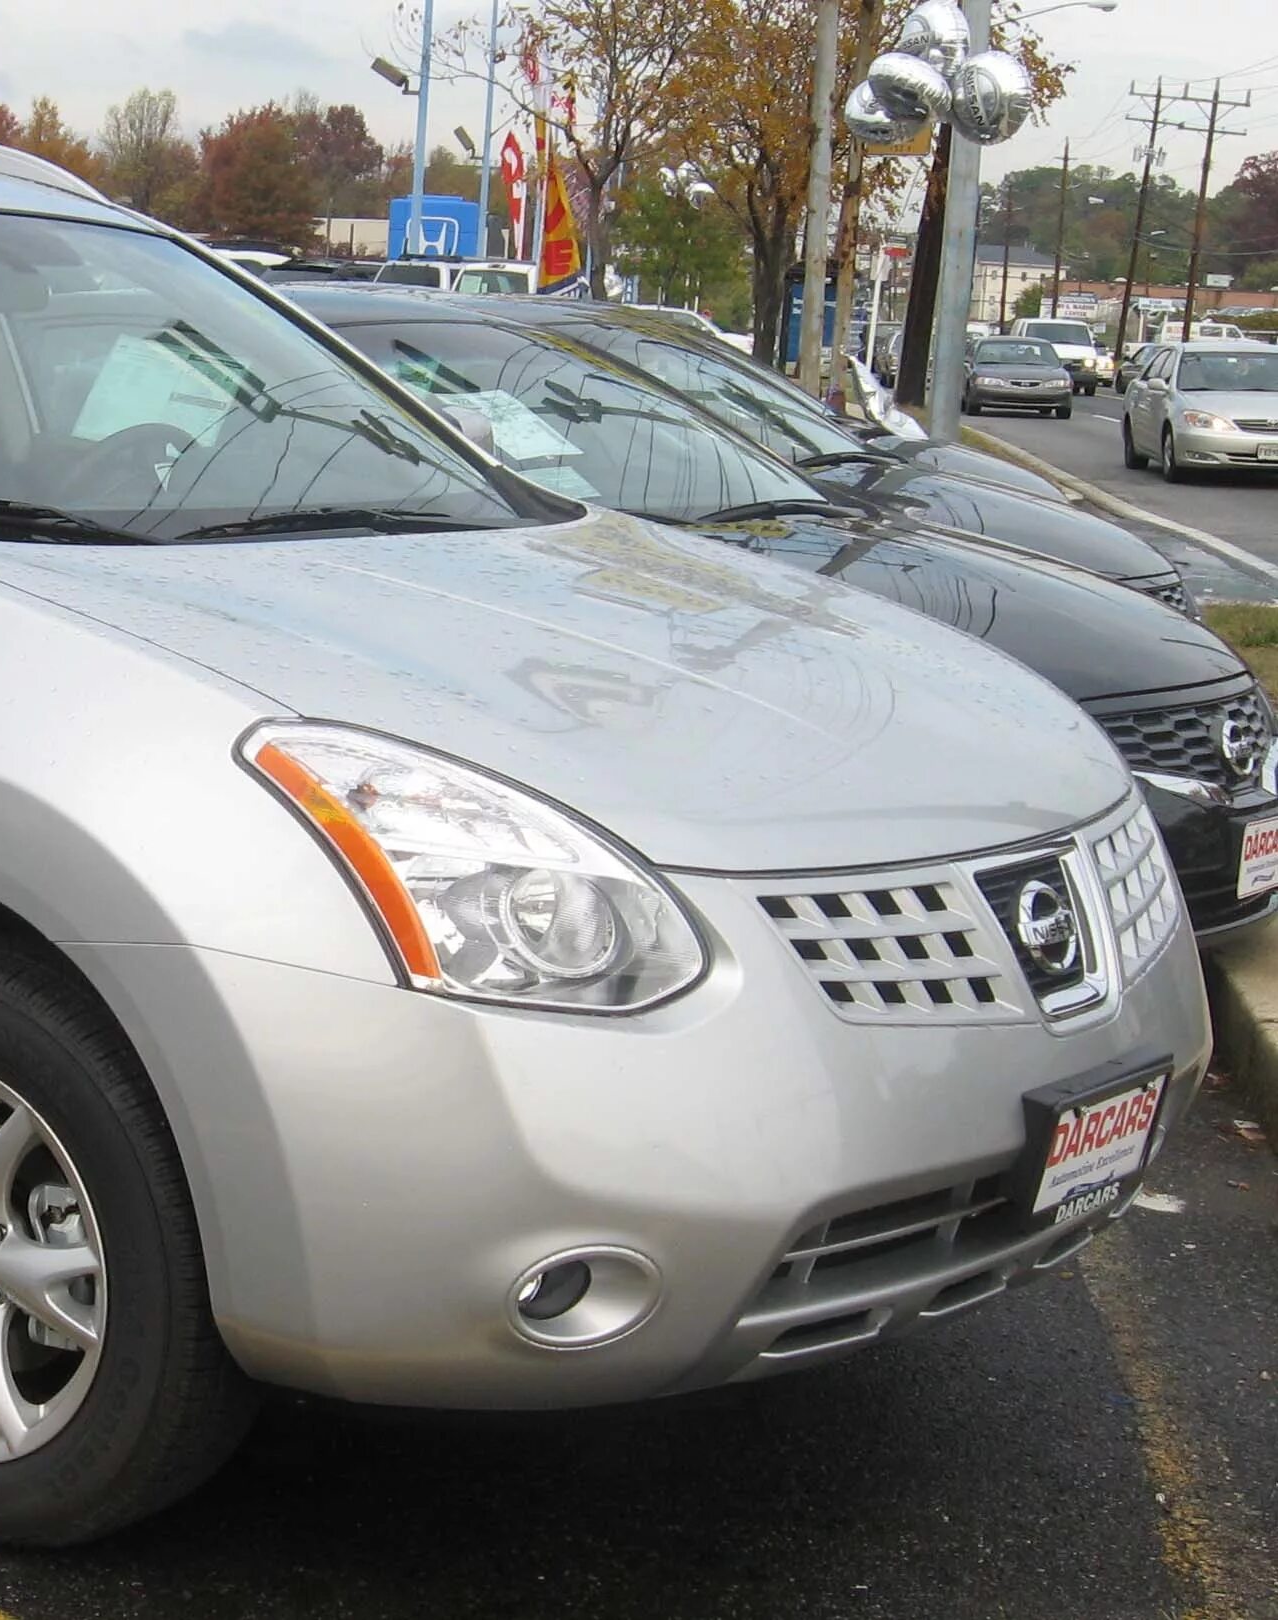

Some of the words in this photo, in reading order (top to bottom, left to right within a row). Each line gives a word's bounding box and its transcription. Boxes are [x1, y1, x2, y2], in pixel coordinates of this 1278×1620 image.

[965, 70, 985, 126] NISSAN
[1047, 1088, 1157, 1168] DARCARS
[1055, 1181, 1121, 1224] DARCARS
